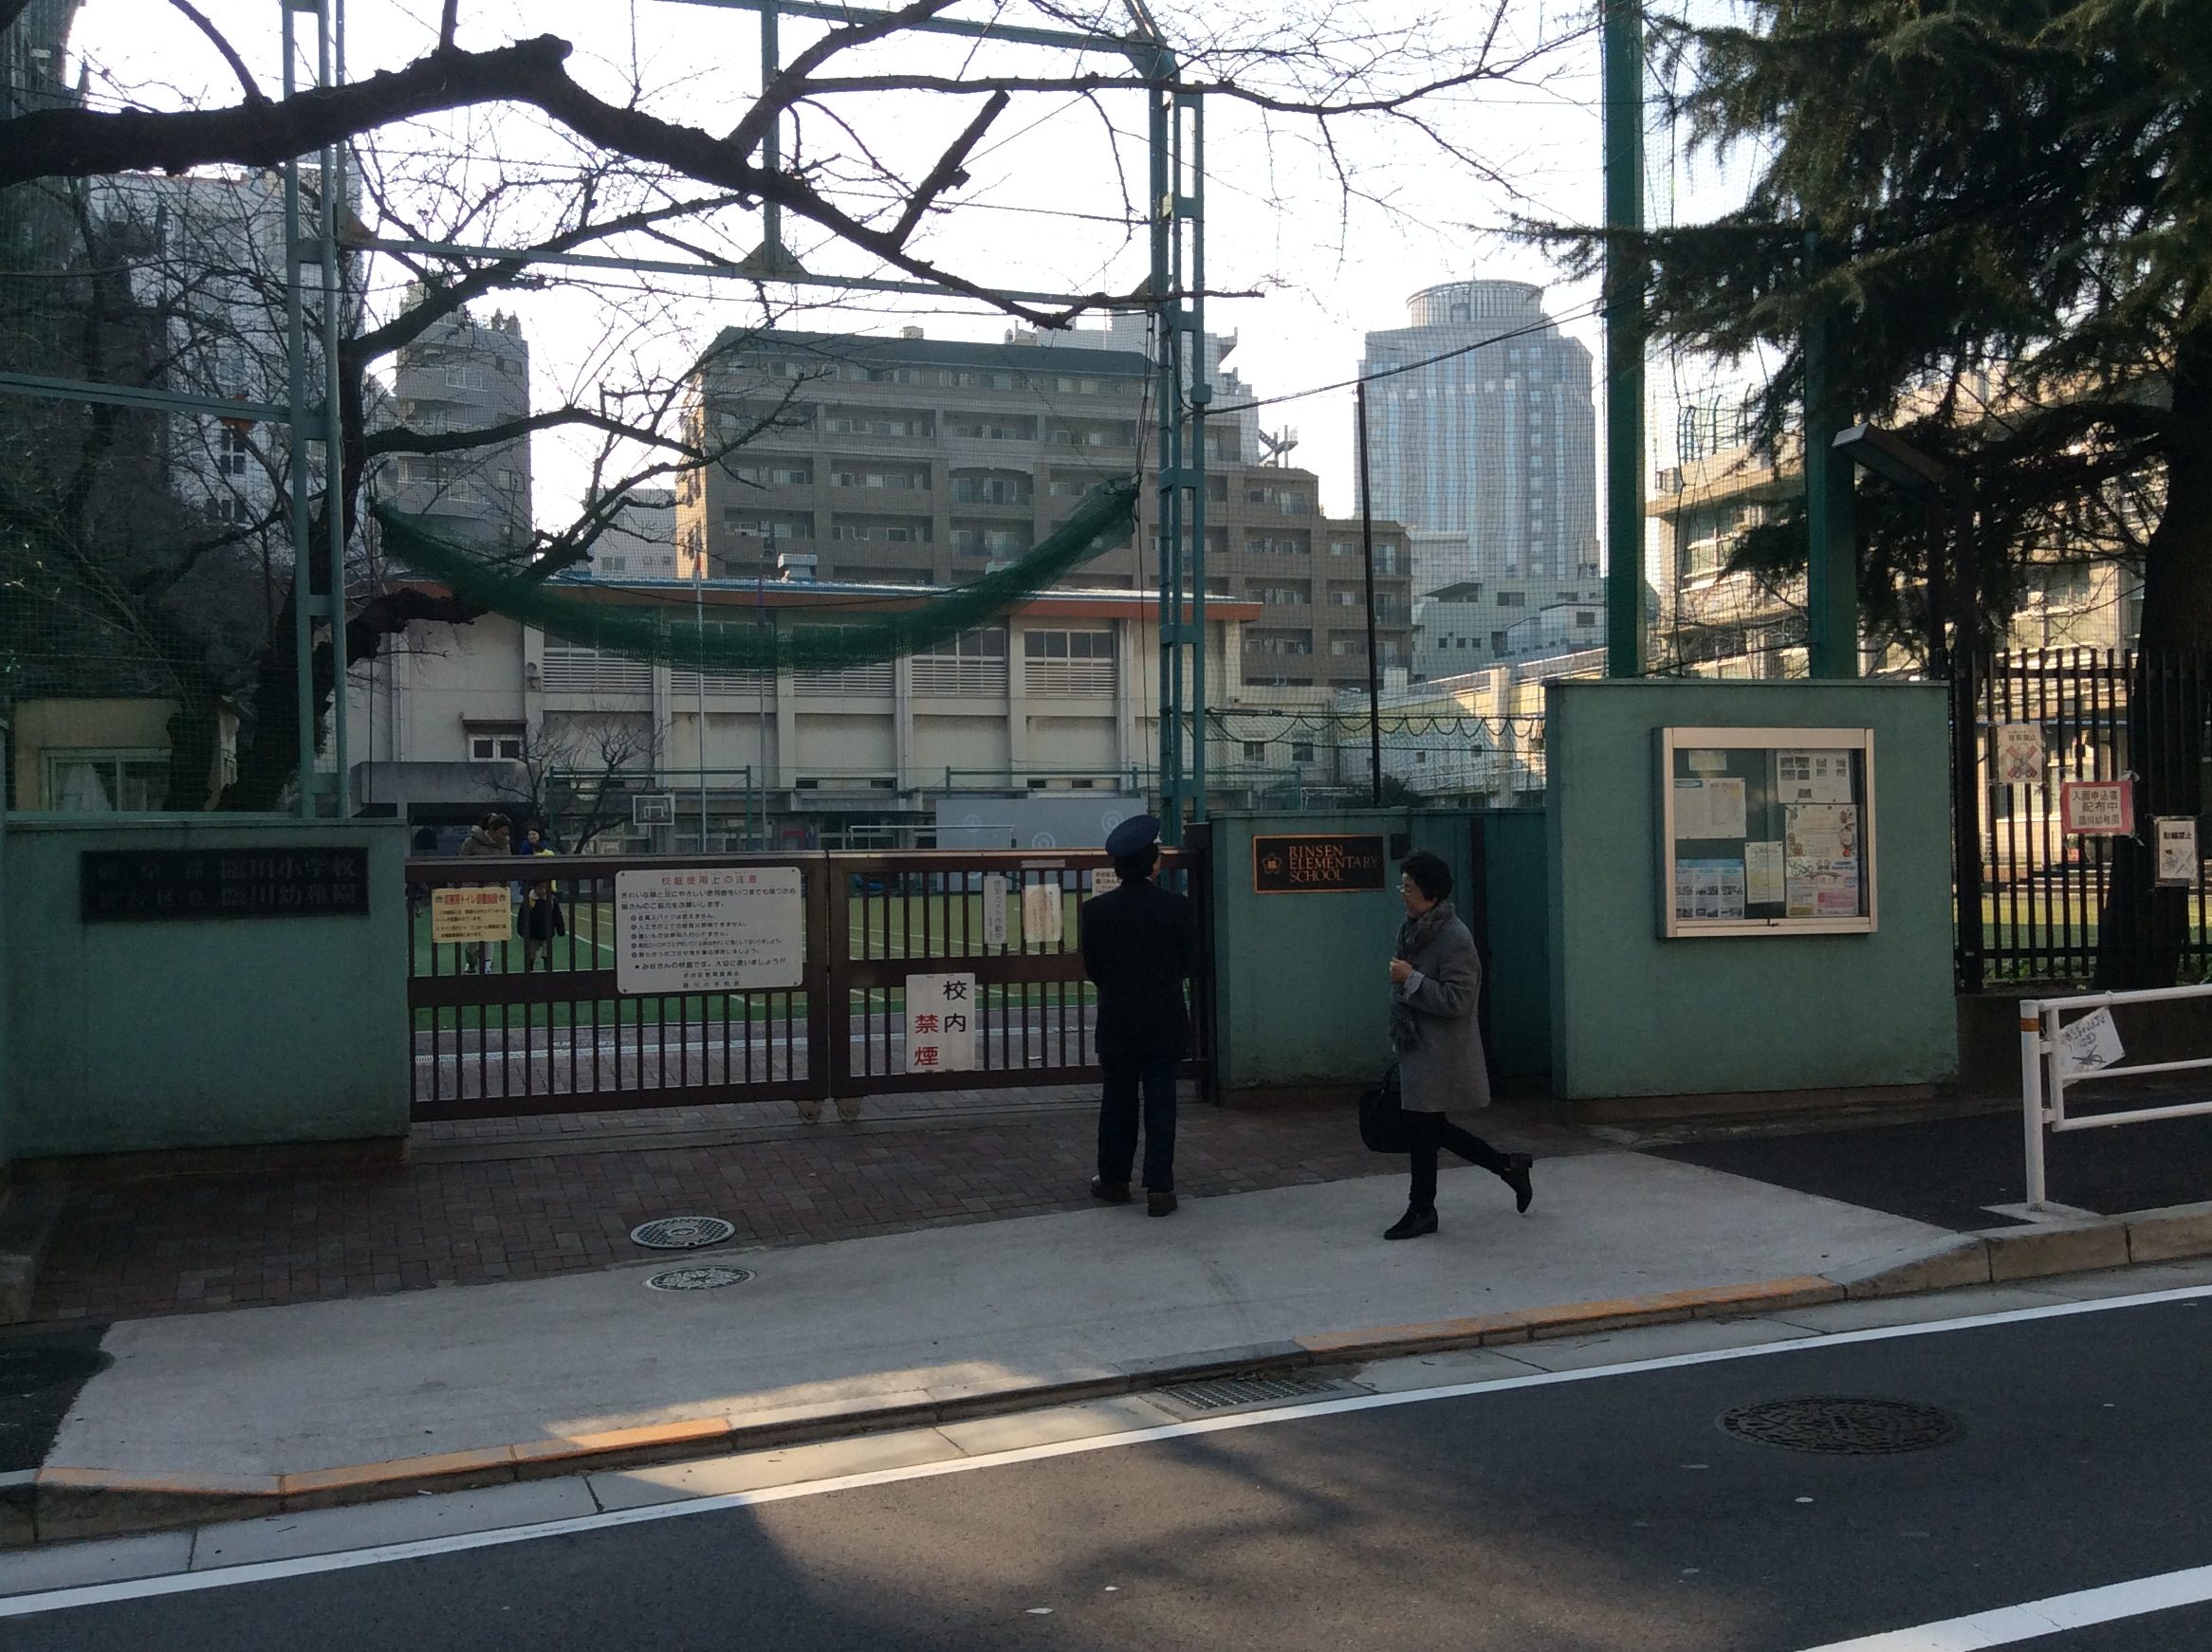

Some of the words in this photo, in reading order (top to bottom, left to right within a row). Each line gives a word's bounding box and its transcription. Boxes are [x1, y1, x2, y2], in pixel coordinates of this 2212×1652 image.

[2072, 790, 2118, 801] 入園申込書
[2082, 801, 2118, 813] 配布中
[1289, 844, 1343, 858] RINSEN
[1290, 855, 1378, 870] ELEMENTARY
[661, 874, 759, 887] 校庭使用上の注意
[1290, 869, 1344, 883] SCHOOL
[943, 981, 968, 1033] 校内
[914, 1014, 938, 1066] 禁煙
